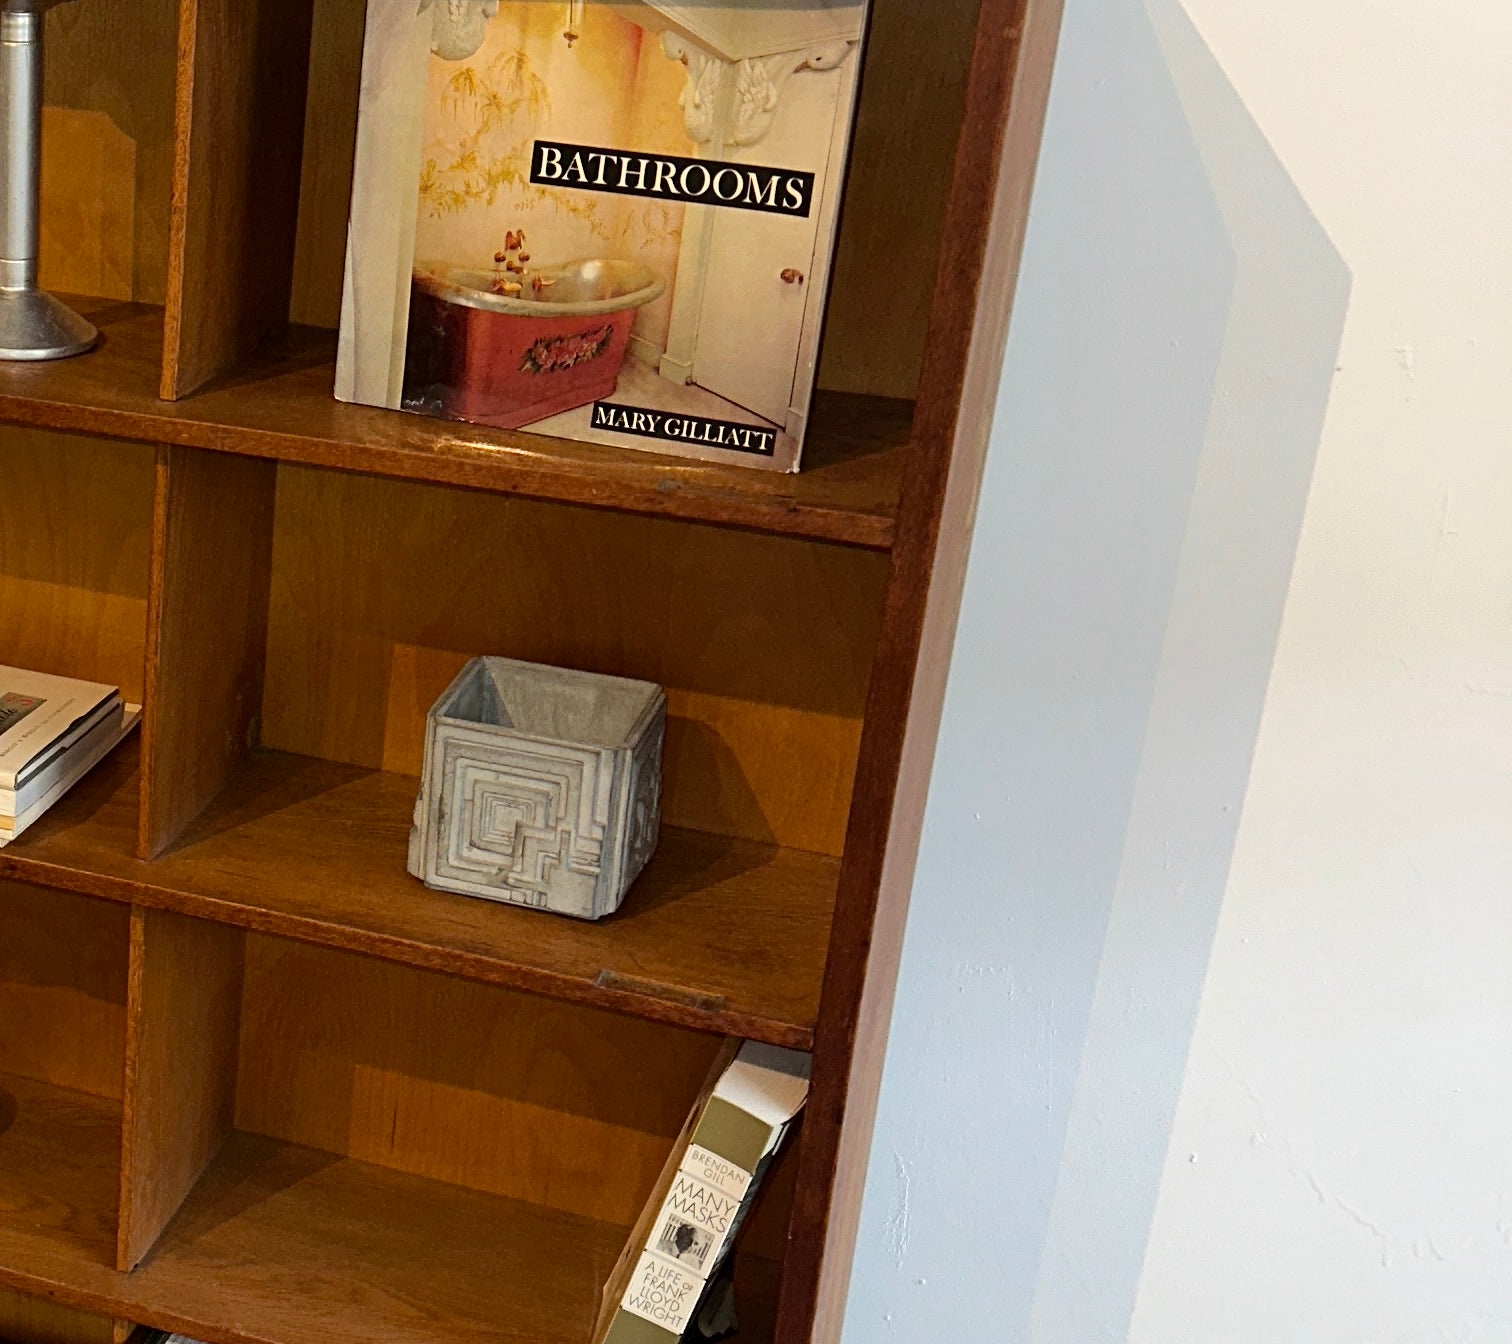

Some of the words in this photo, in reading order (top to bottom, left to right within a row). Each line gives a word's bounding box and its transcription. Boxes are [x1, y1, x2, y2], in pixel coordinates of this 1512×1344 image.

[536, 145, 806, 211] BATHROOMS
[595, 405, 662, 435] MARY
[663, 417, 774, 453] GILLIATT
[691, 1149, 746, 1185] BRENDAN
[703, 1167, 725, 1186] GILL
[668, 1192, 728, 1234] MASKS
[675, 1177, 736, 1215] MANY
[643, 1275, 689, 1302] FRANK
[645, 1260, 656, 1272] A
[658, 1266, 682, 1284] LIFE
[629, 1293, 684, 1329] WRIGHT
[639, 1286, 681, 1313] LLOYD
